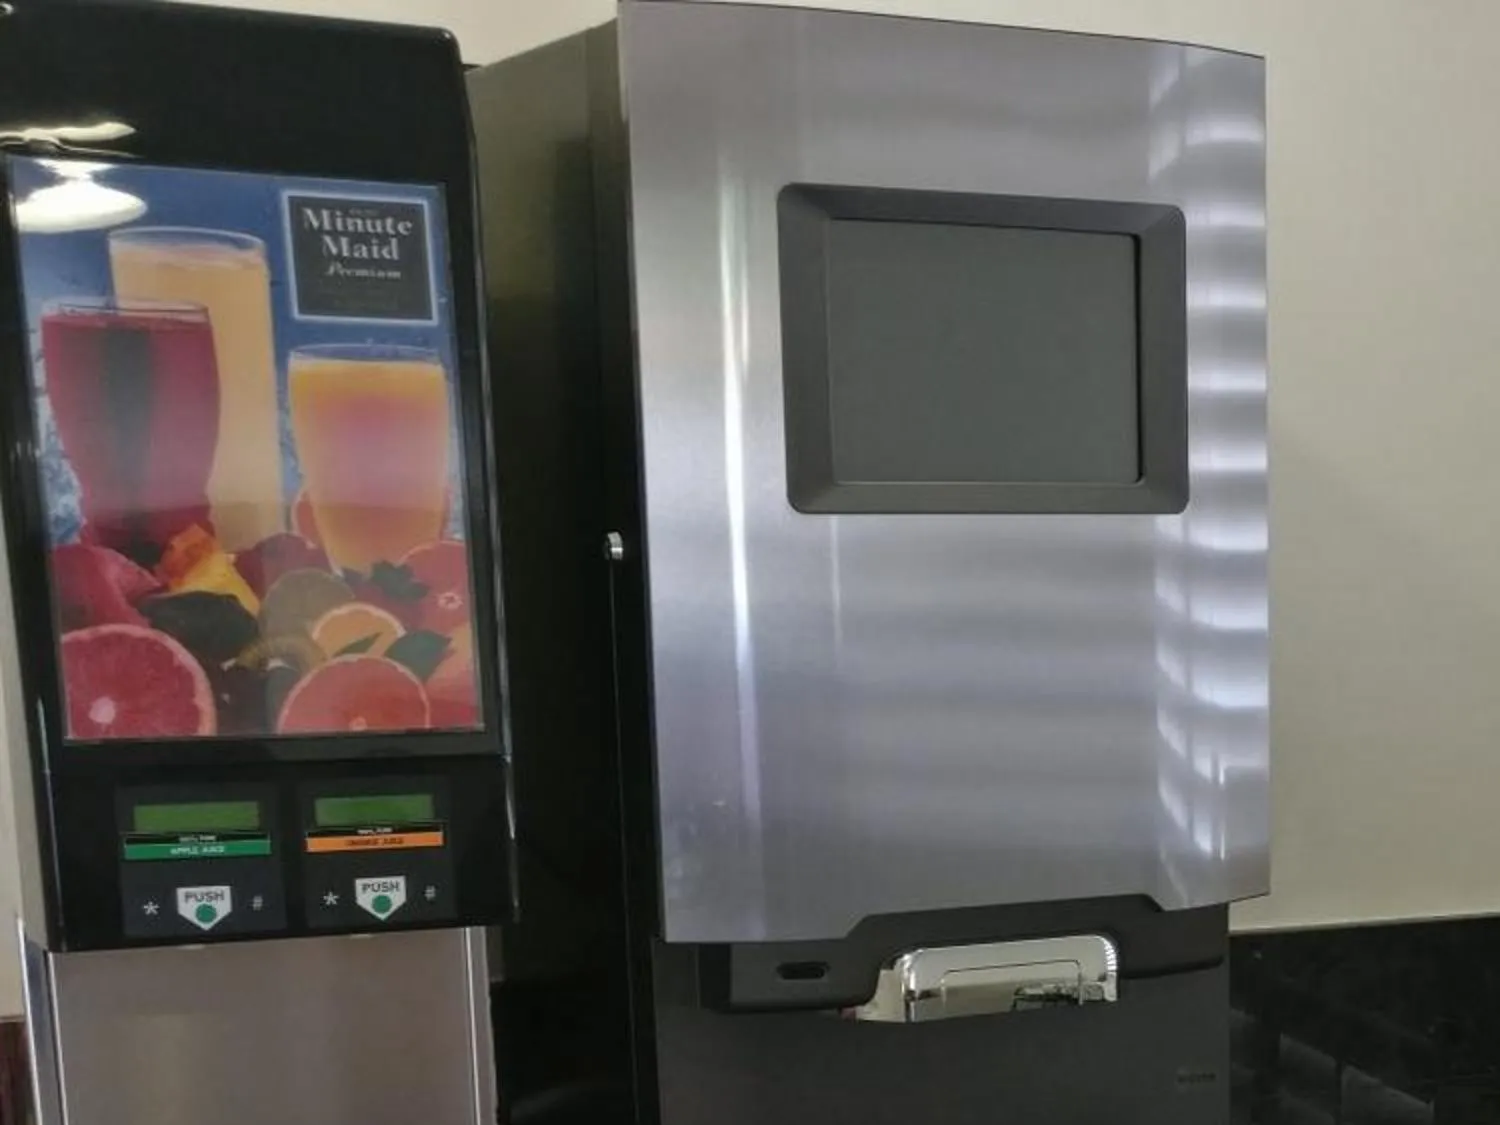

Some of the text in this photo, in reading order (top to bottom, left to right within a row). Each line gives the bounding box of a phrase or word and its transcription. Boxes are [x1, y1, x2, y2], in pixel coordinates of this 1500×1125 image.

[302, 207, 413, 236] Minute
[321, 234, 400, 261] Maid
[183, 890, 225, 904] PUSH
[361, 880, 400, 894] PUSH
